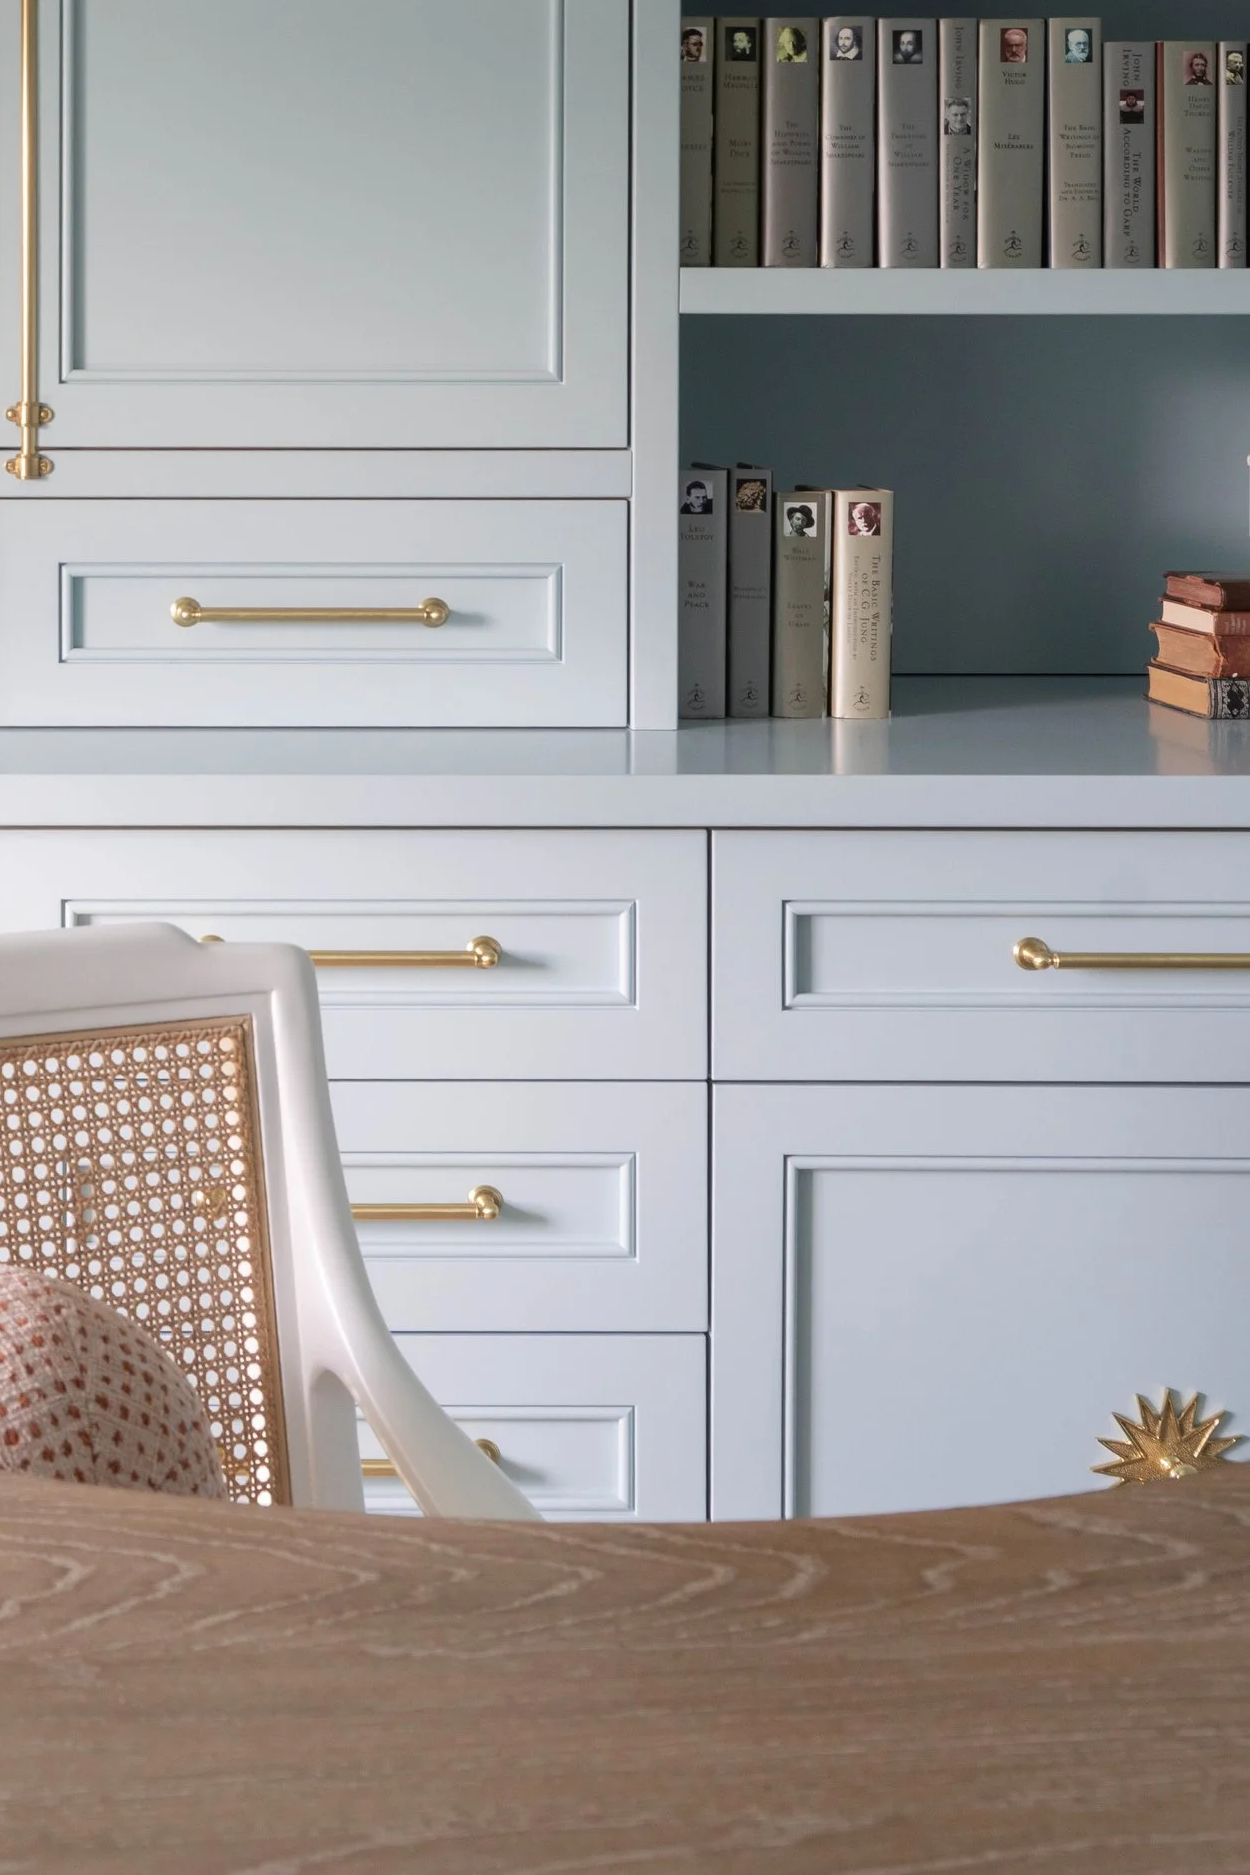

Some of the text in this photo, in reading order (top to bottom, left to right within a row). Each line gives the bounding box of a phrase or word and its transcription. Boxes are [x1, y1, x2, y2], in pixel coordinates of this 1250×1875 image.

[954, 27, 965, 90] JOHN IRVING
[1122, 49, 1132, 87] IRVING
[1132, 54, 1143, 82] JOHN
[1002, 70, 1027, 78] VICTOR
[1122, 128, 1132, 237] ACCORDING TO GARP
[1132, 151, 1142, 212] THE WORLD
[953, 186, 962, 211] YEAR
[680, 533, 714, 541] TOLSTOY
[687, 580, 706, 588] WAR
[861, 572, 869, 584] OF
[684, 600, 710, 608] PEACE
[870, 555, 881, 661] THE BASIC WRITINGS
[860, 618, 870, 644] JUNG
